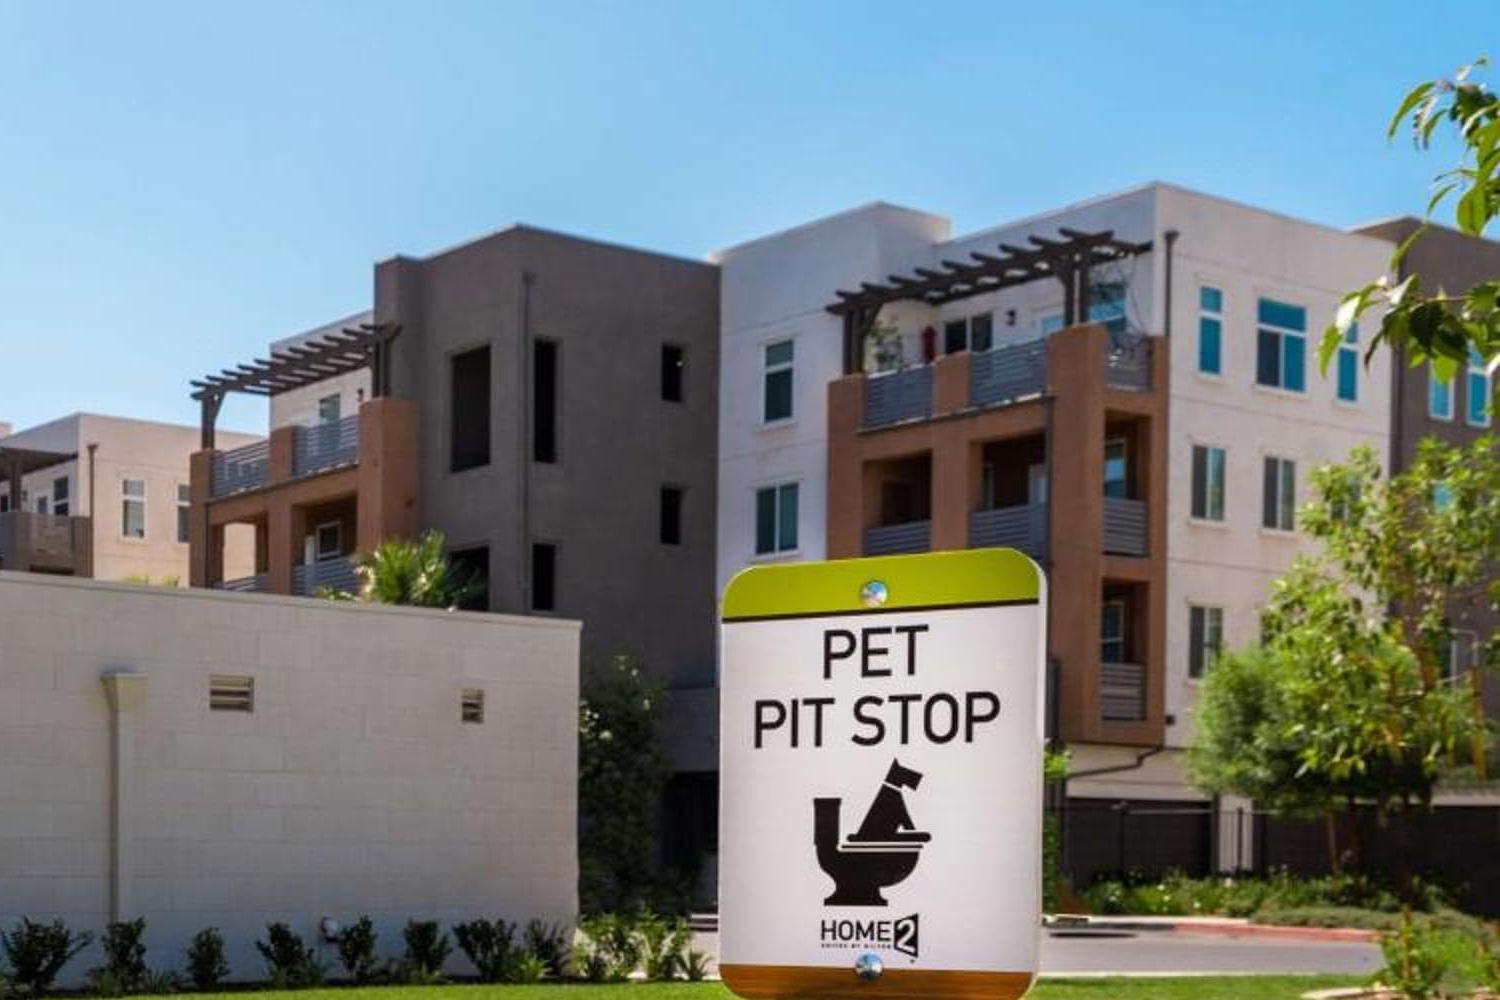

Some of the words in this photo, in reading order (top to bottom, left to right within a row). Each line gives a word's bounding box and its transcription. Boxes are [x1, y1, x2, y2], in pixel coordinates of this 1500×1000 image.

[823, 624, 929, 680] PET
[754, 697, 835, 748] PIT
[852, 691, 1001, 746] STOP
